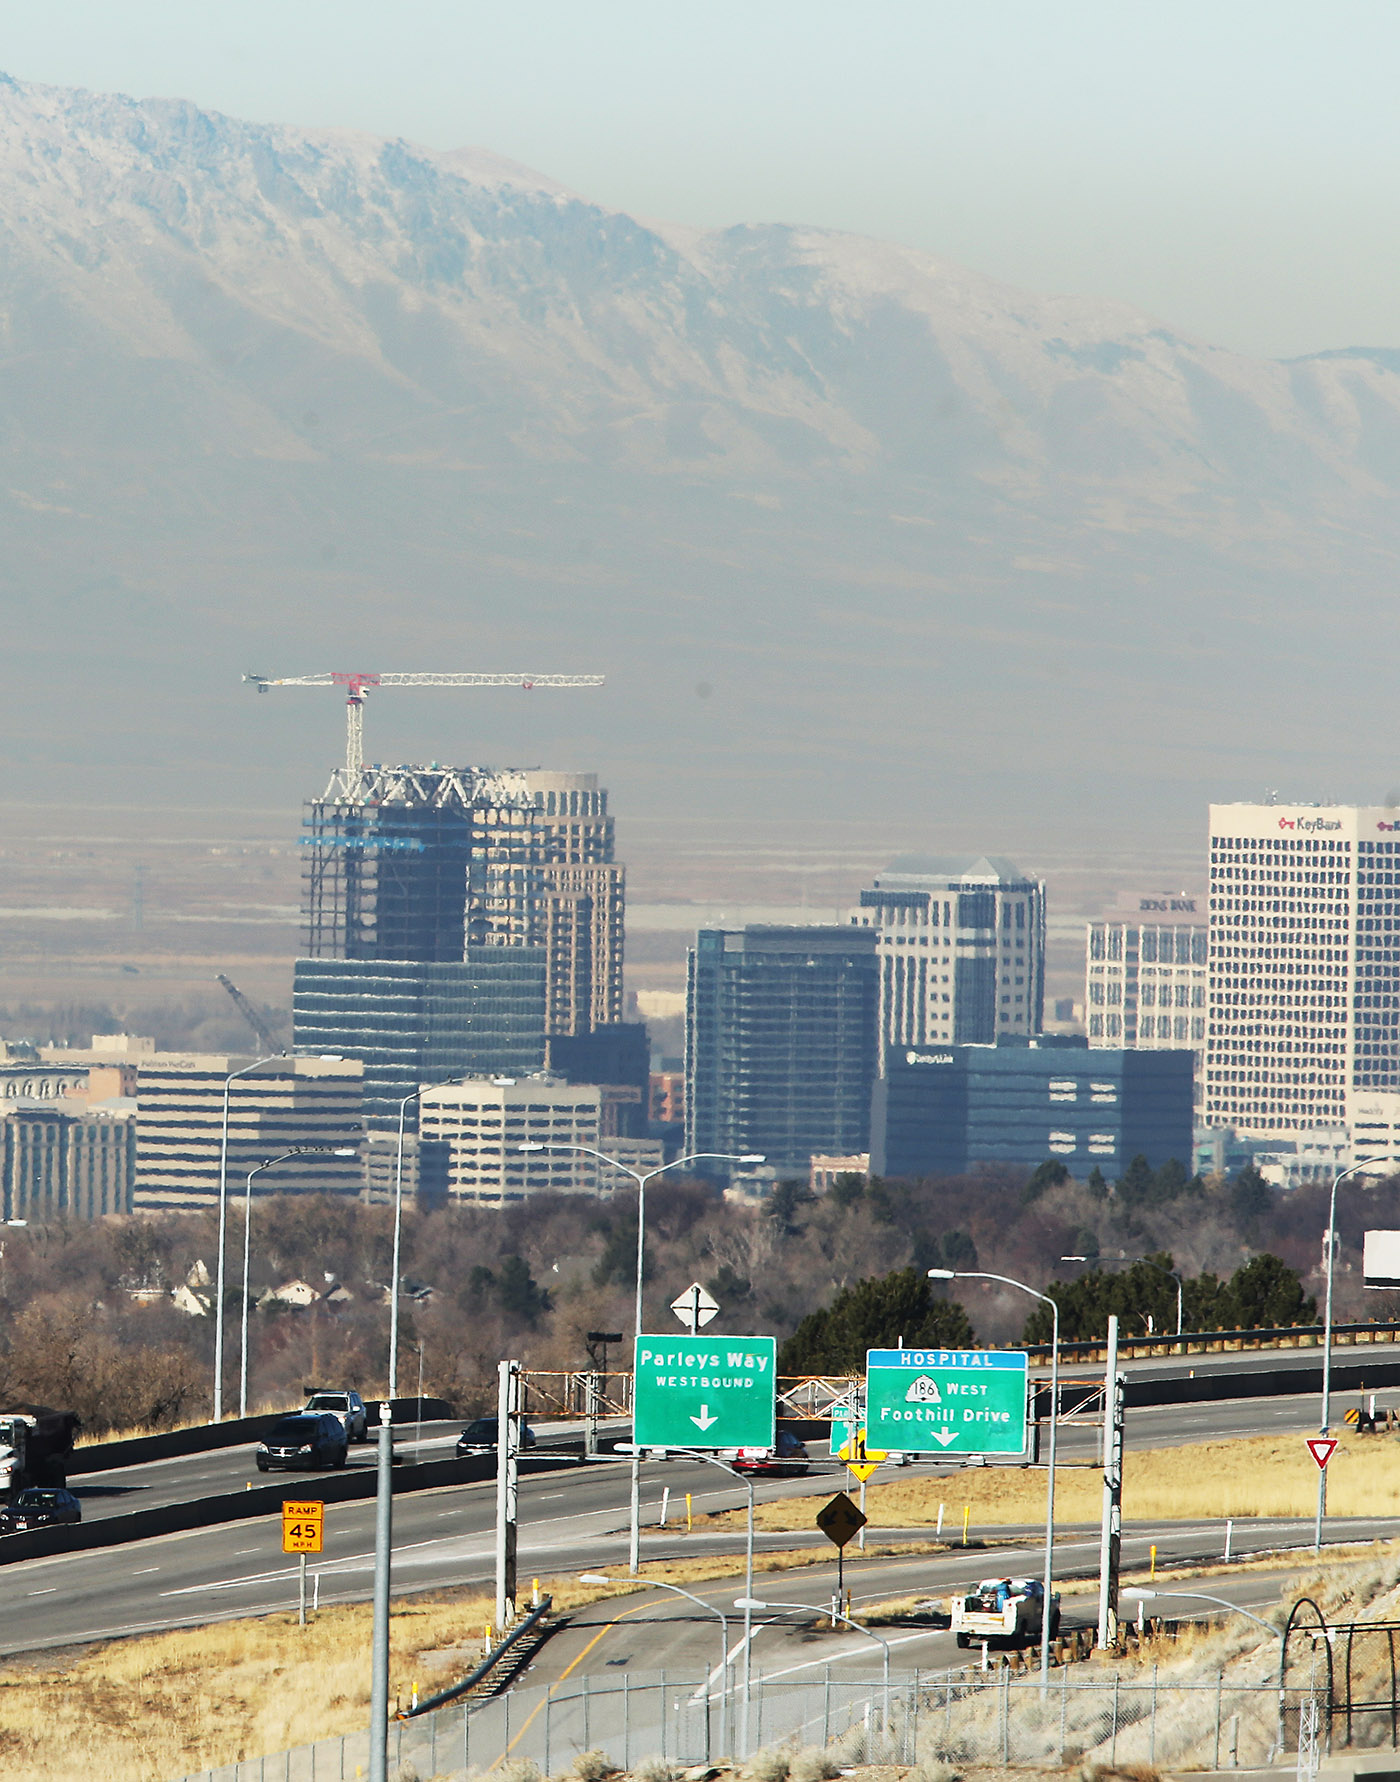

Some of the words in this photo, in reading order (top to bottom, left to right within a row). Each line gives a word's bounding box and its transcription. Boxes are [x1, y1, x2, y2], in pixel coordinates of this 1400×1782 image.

[1297, 816, 1343, 834] KeyBank
[640, 1349, 720, 1370] Parleys
[727, 1352, 768, 1372] Way
[901, 1353, 993, 1367] HOSPITAL
[656, 1376, 754, 1388] WESTBOUND
[914, 1382, 935, 1396] 186
[946, 1383, 988, 1396] WEST
[880, 1407, 954, 1422] Foothill
[963, 1407, 1011, 1422] Drive
[288, 1506, 318, 1515] RAMP
[289, 1524, 316, 1539] 45
